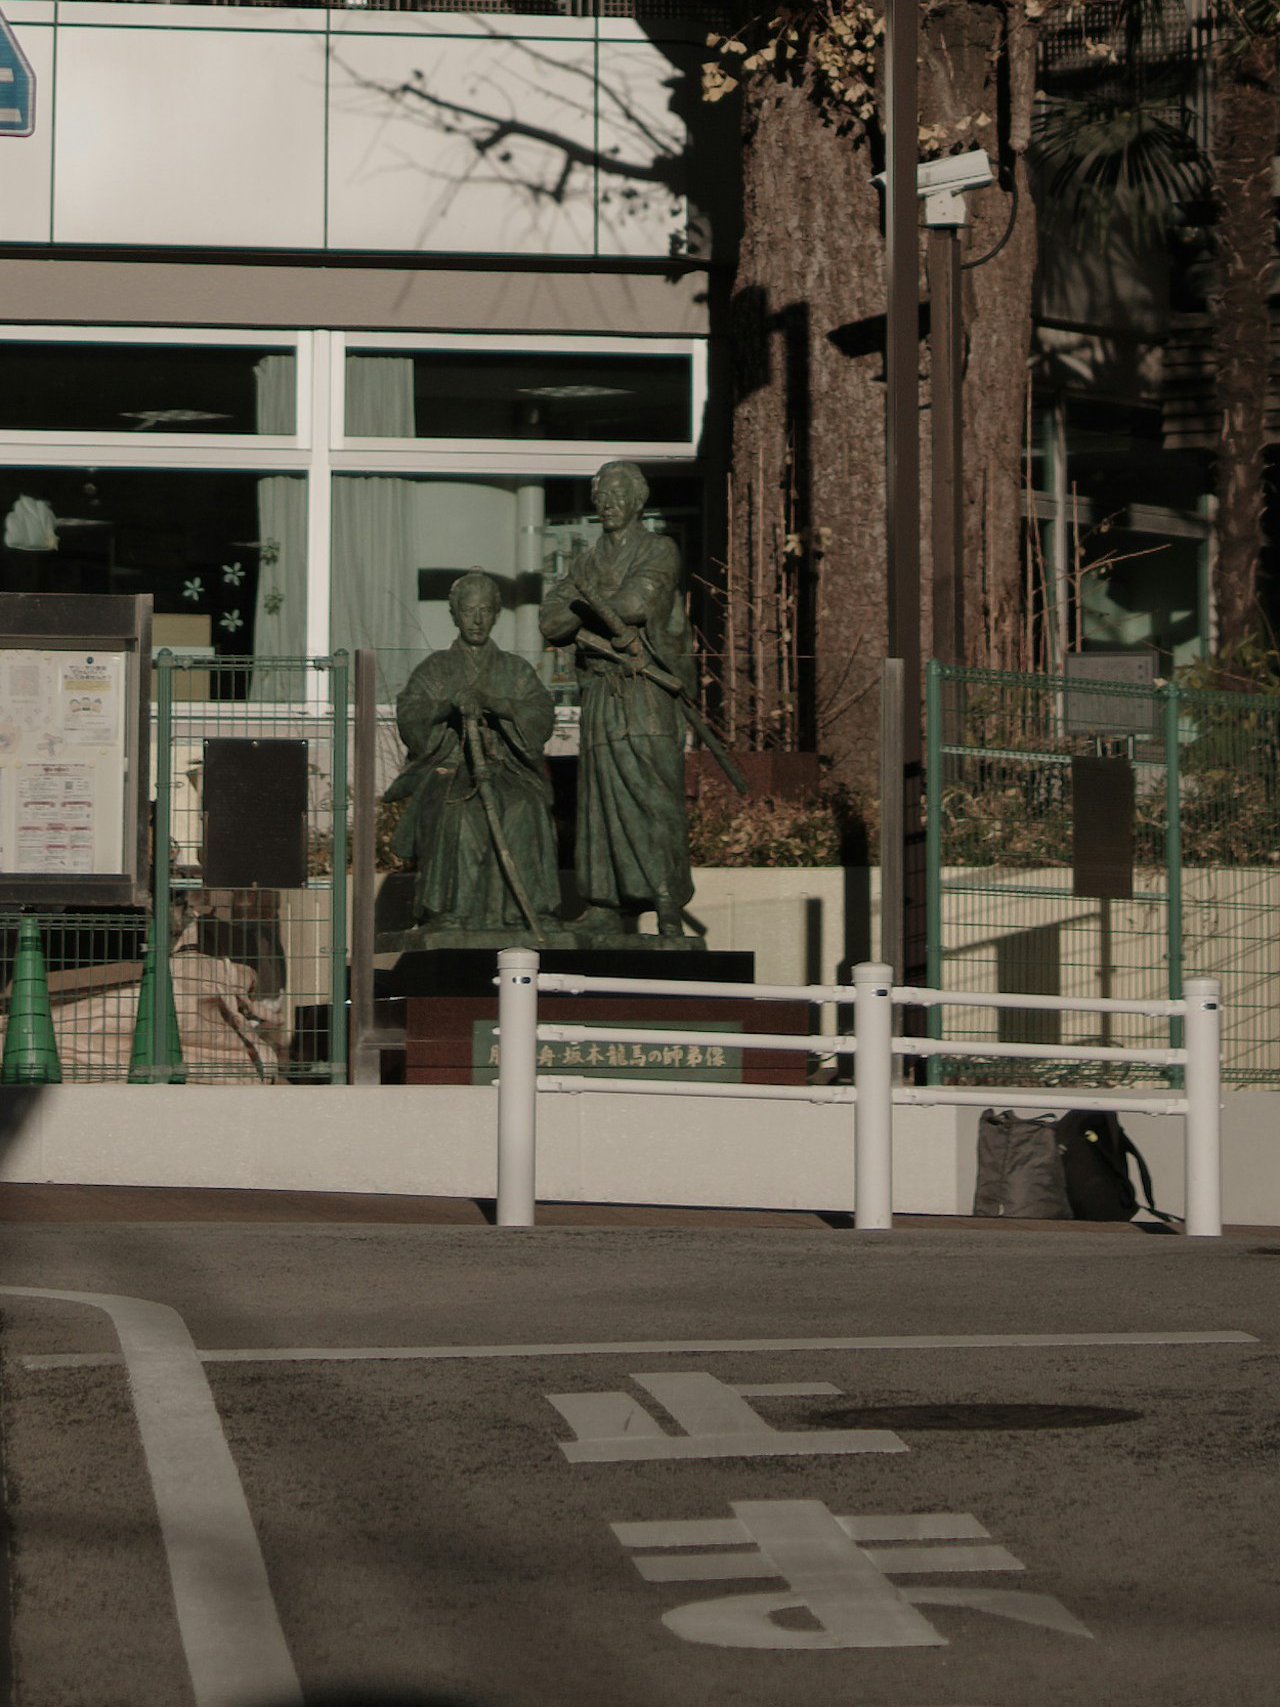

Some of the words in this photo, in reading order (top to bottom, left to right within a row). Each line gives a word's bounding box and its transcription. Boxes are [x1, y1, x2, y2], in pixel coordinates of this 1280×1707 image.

[488, 1043, 727, 1068] 舟・坂本龍馬の師弟像
